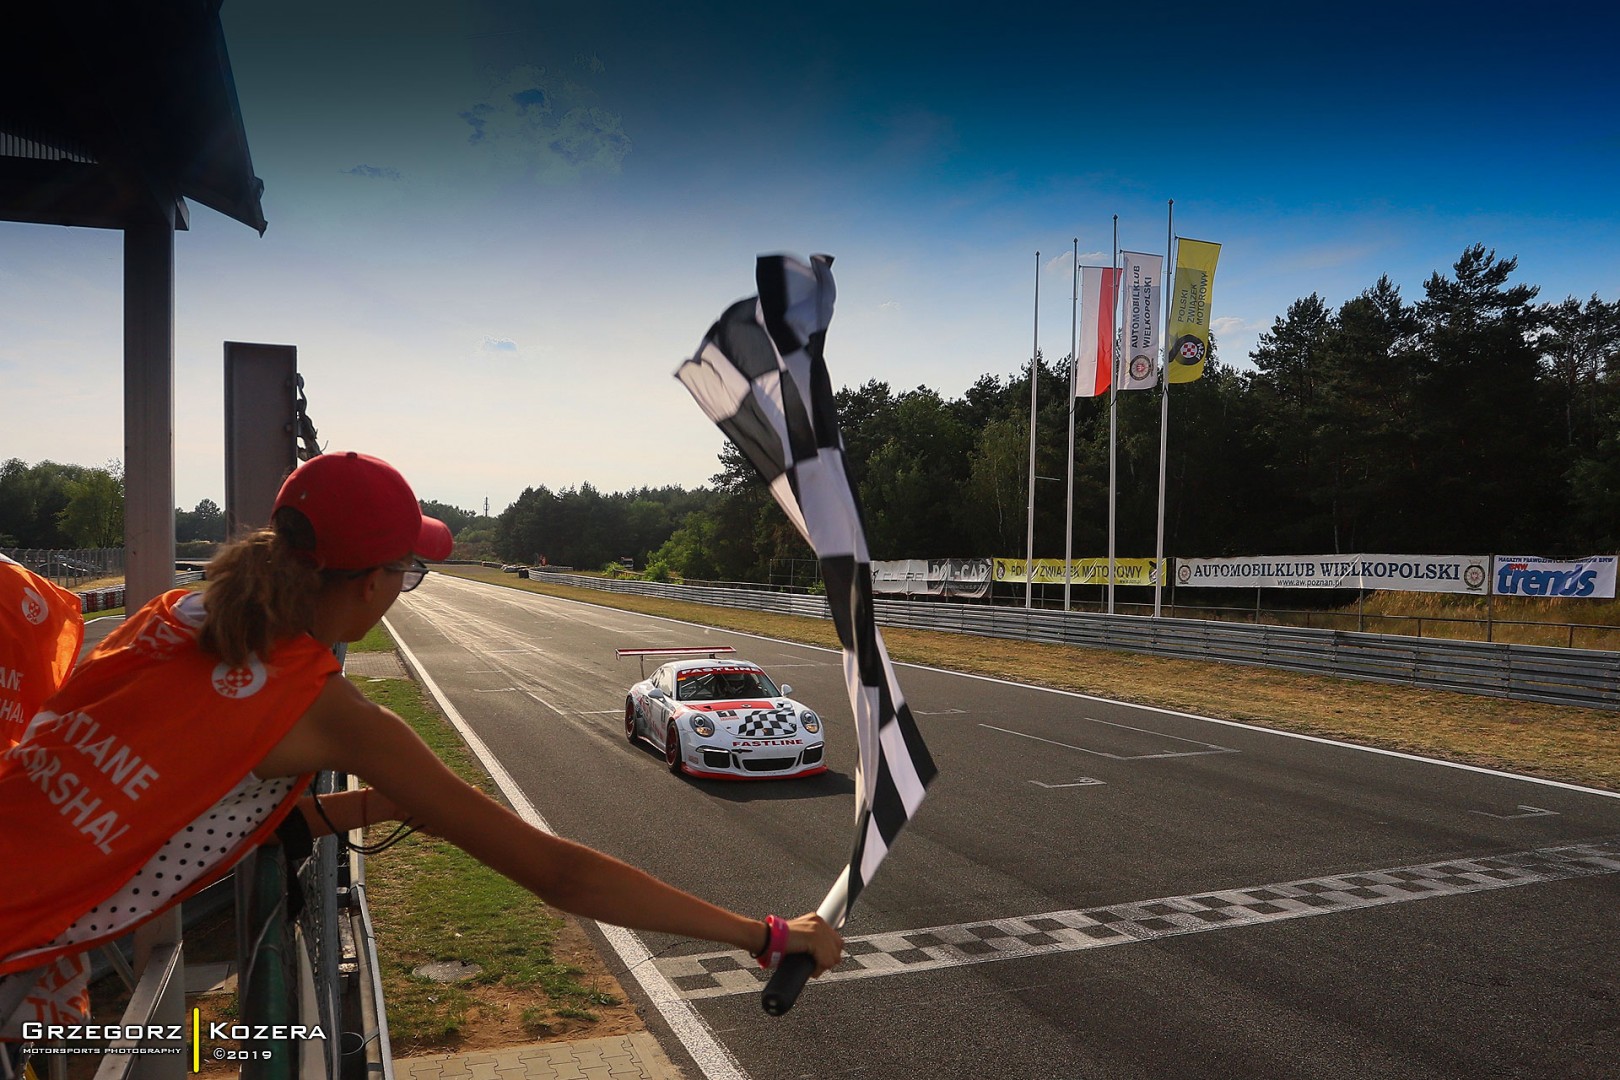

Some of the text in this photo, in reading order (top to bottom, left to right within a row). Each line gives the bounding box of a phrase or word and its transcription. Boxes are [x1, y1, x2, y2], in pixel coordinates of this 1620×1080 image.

[1131, 265, 1141, 348] AUTOMOBILKLUB
[1142, 276, 1152, 349] WIELKOPOLSKI
[1177, 289, 1189, 323] POLSKI
[1196, 272, 1209, 326] MOTOROWY
[1194, 562, 1460, 580] AUTOMOBILKLUB WIELKOPOLSKI
[1498, 564, 1597, 596] trends
[681, 666, 762, 675] FASTLINE
[732, 739, 804, 747] FASTLINE
